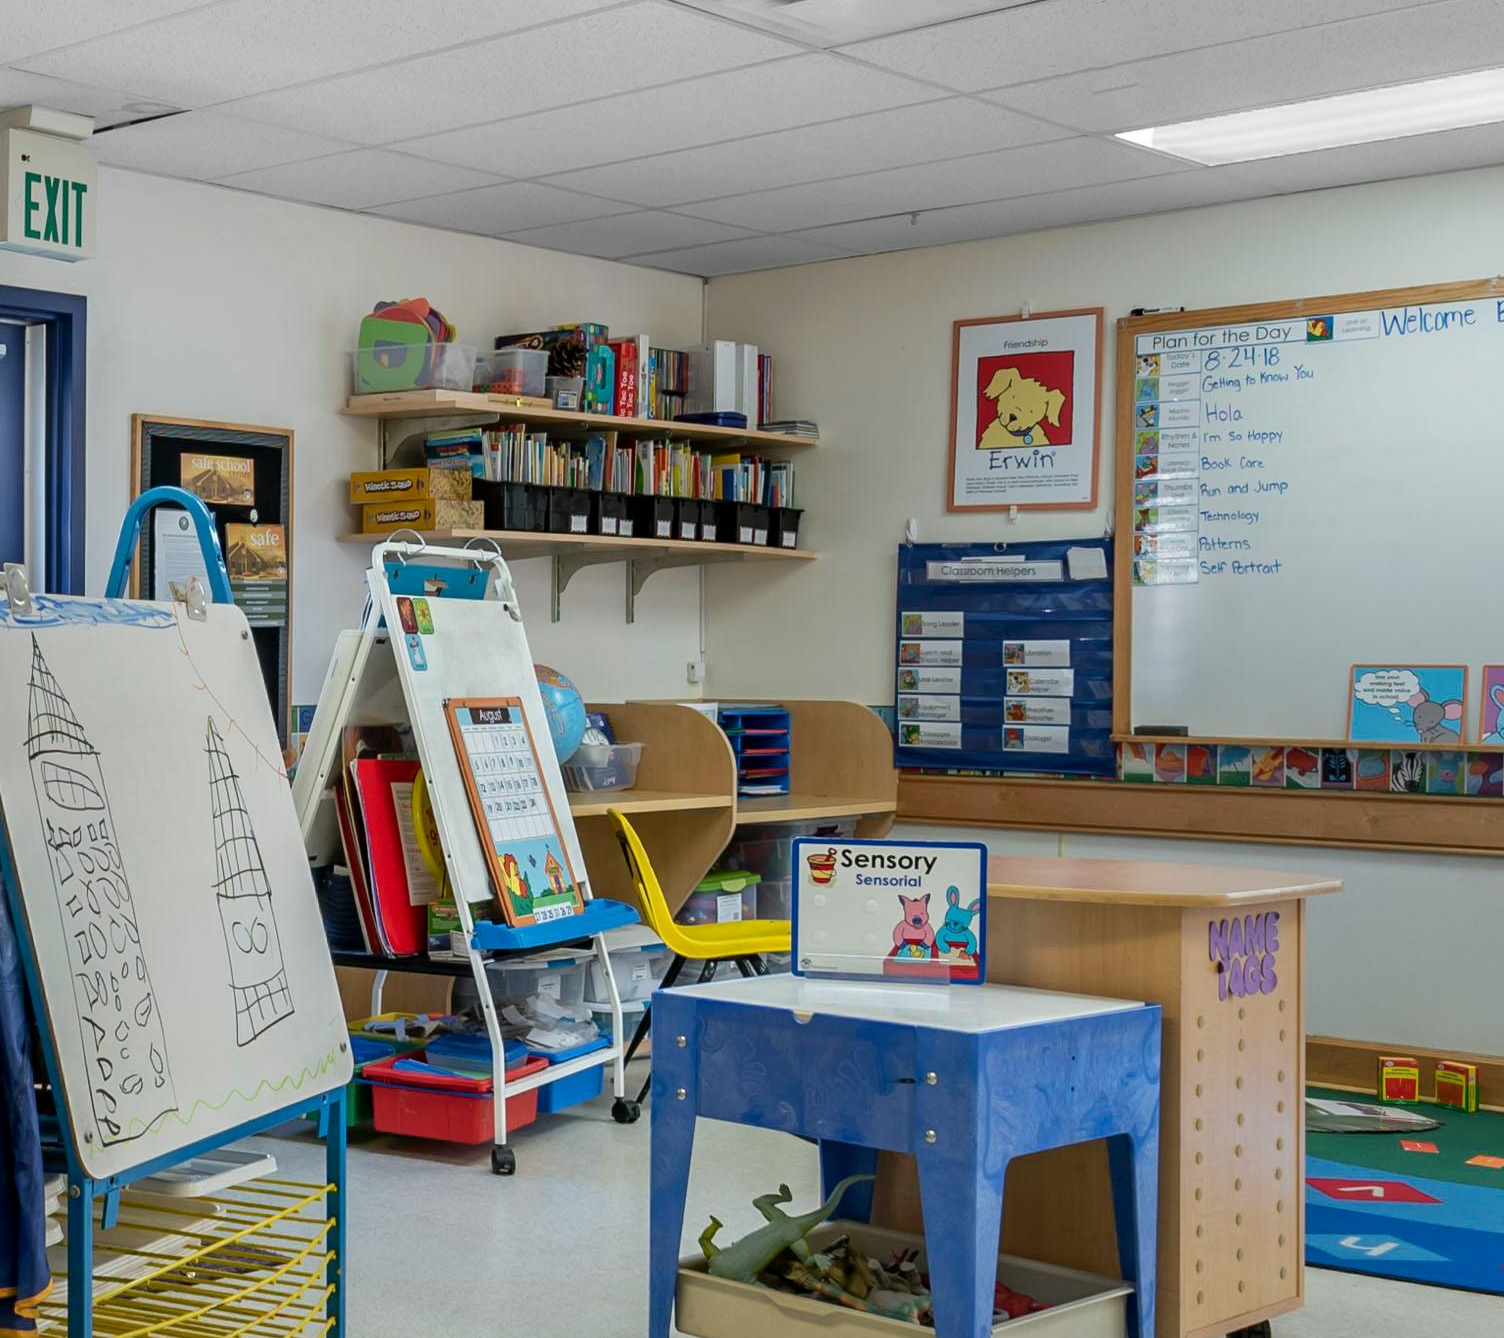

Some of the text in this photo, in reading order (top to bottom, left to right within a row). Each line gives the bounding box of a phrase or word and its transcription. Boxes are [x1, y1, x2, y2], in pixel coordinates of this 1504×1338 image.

[24, 171, 87, 248] EXIT
[1382, 305, 1477, 336] Welcome
[1004, 338, 1048, 349] Friendship
[1153, 325, 1292, 349] Plan for the Day
[1202, 365, 1314, 392] Getting to Know You
[1206, 403, 1243, 423] Hola
[1204, 430, 1283, 444] I'm So Happy
[1201, 457, 1264, 470] Book Care
[1200, 481, 1288, 497] Run and Jump
[1200, 511, 1259, 525] Technology
[251, 529, 279, 546] safe
[1199, 537, 1251, 551] Patterns
[941, 566, 1037, 577] Classroom Helpers
[1200, 561, 1226, 574] Self
[1232, 559, 1282, 574] Portrait
[479, 709, 502, 723] August
[841, 849, 937, 875] Sensory
[855, 874, 922, 887] Sensorial
[1209, 911, 1280, 961] NAME
[1216, 954, 1277, 1001] TAGS
